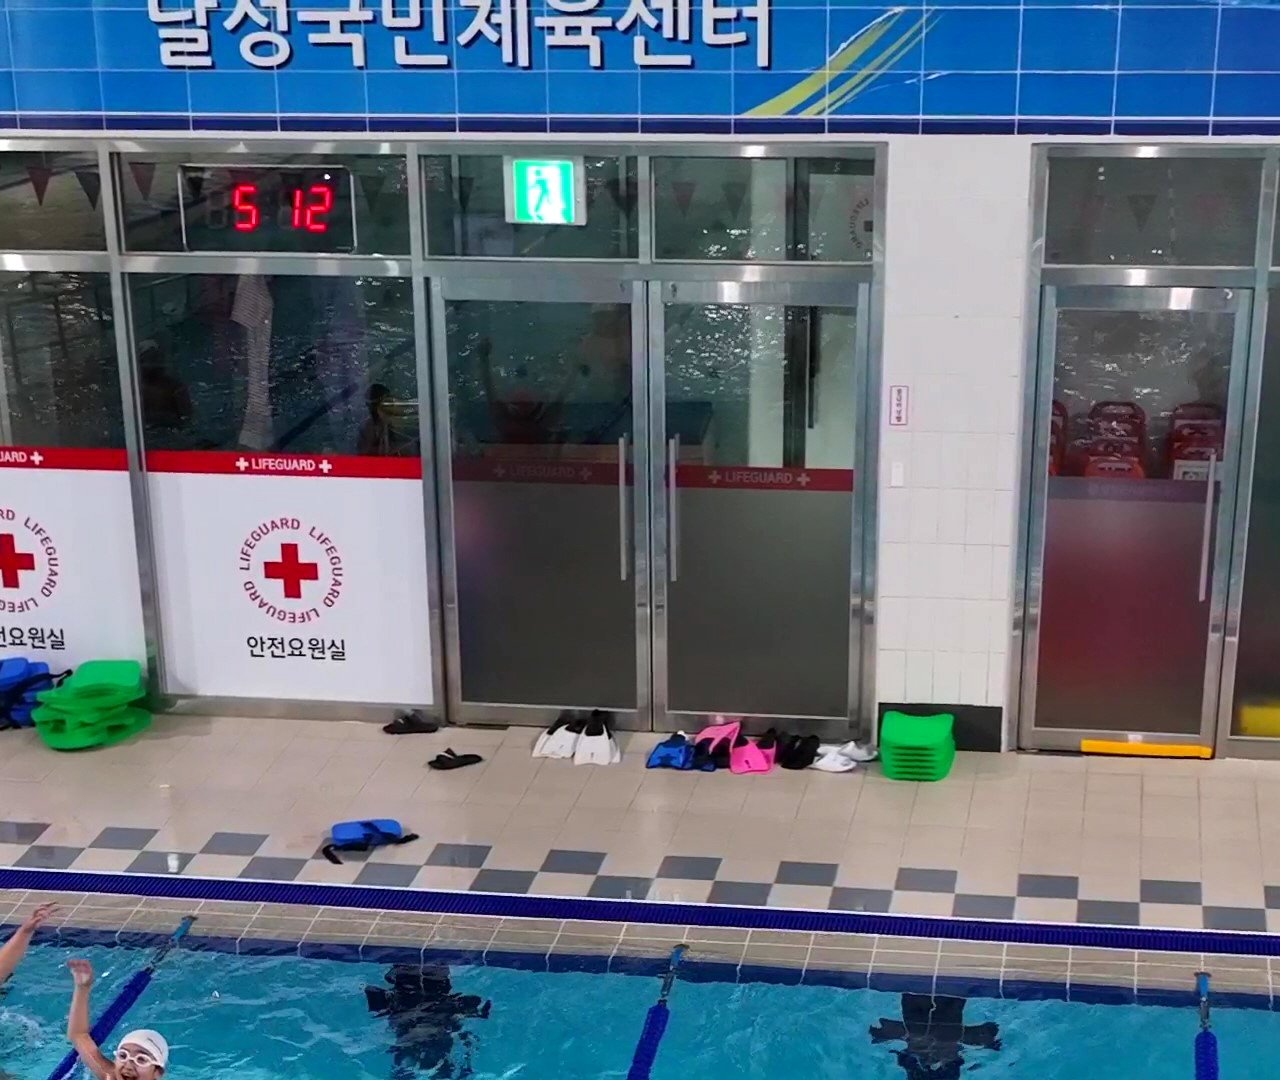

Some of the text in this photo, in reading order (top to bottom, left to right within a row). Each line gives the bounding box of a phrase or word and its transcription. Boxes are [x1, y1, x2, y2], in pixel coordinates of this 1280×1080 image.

[148, 0, 775, 70] 달성국민체육센터
[251, 458, 317, 472] LIFEGUARD
[509, 464, 576, 481] LIFEGUARD
[724, 471, 794, 485] LIFEGUARD
[23, 516, 59, 598] LIFEGUARD
[239, 517, 344, 624] LIFEGUARD LIFEGUARD LIFEGUARD
[245, 635, 348, 662] 안전요원실
